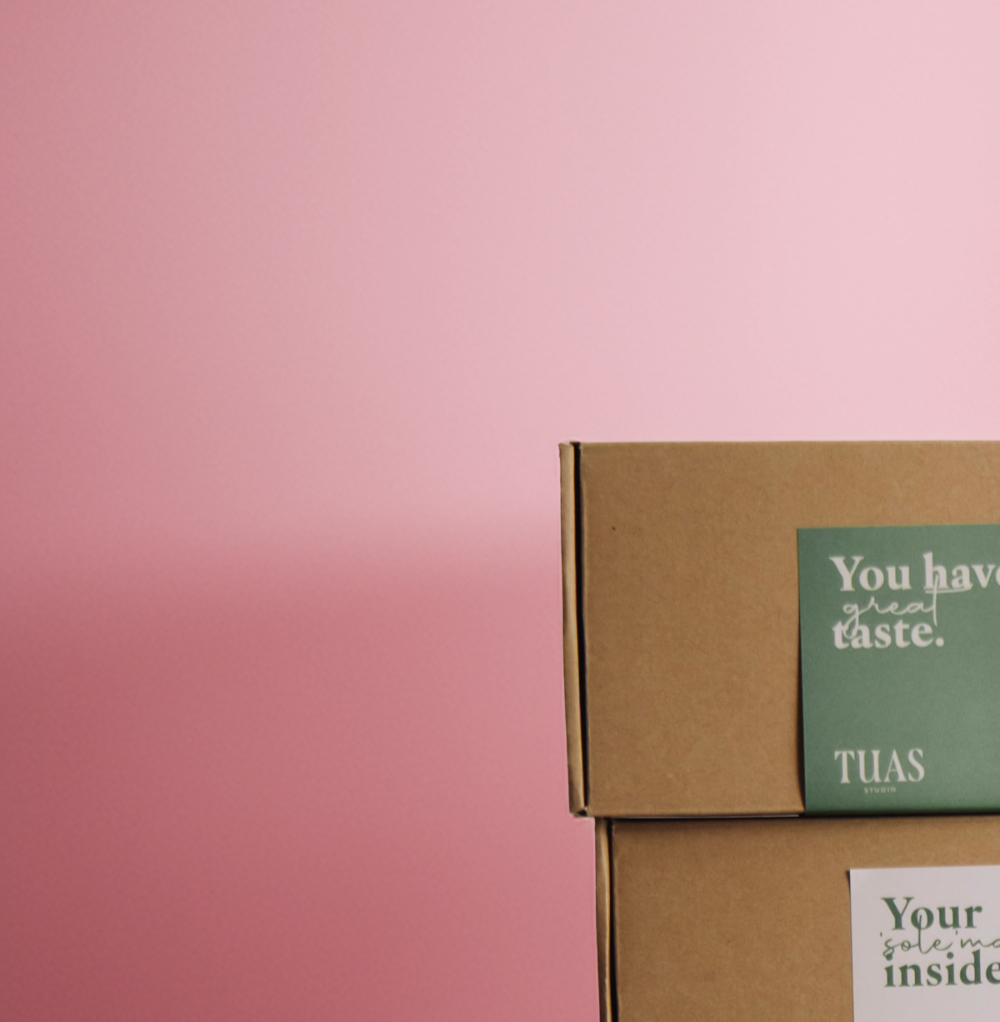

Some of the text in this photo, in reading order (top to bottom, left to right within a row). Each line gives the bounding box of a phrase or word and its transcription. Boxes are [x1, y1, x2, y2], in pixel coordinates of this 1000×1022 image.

[829, 555, 912, 591] You
[842, 575, 973, 639] great
[832, 619, 944, 649] taste.
[834, 748, 925, 784] TUAS
[880, 896, 983, 931] Your
